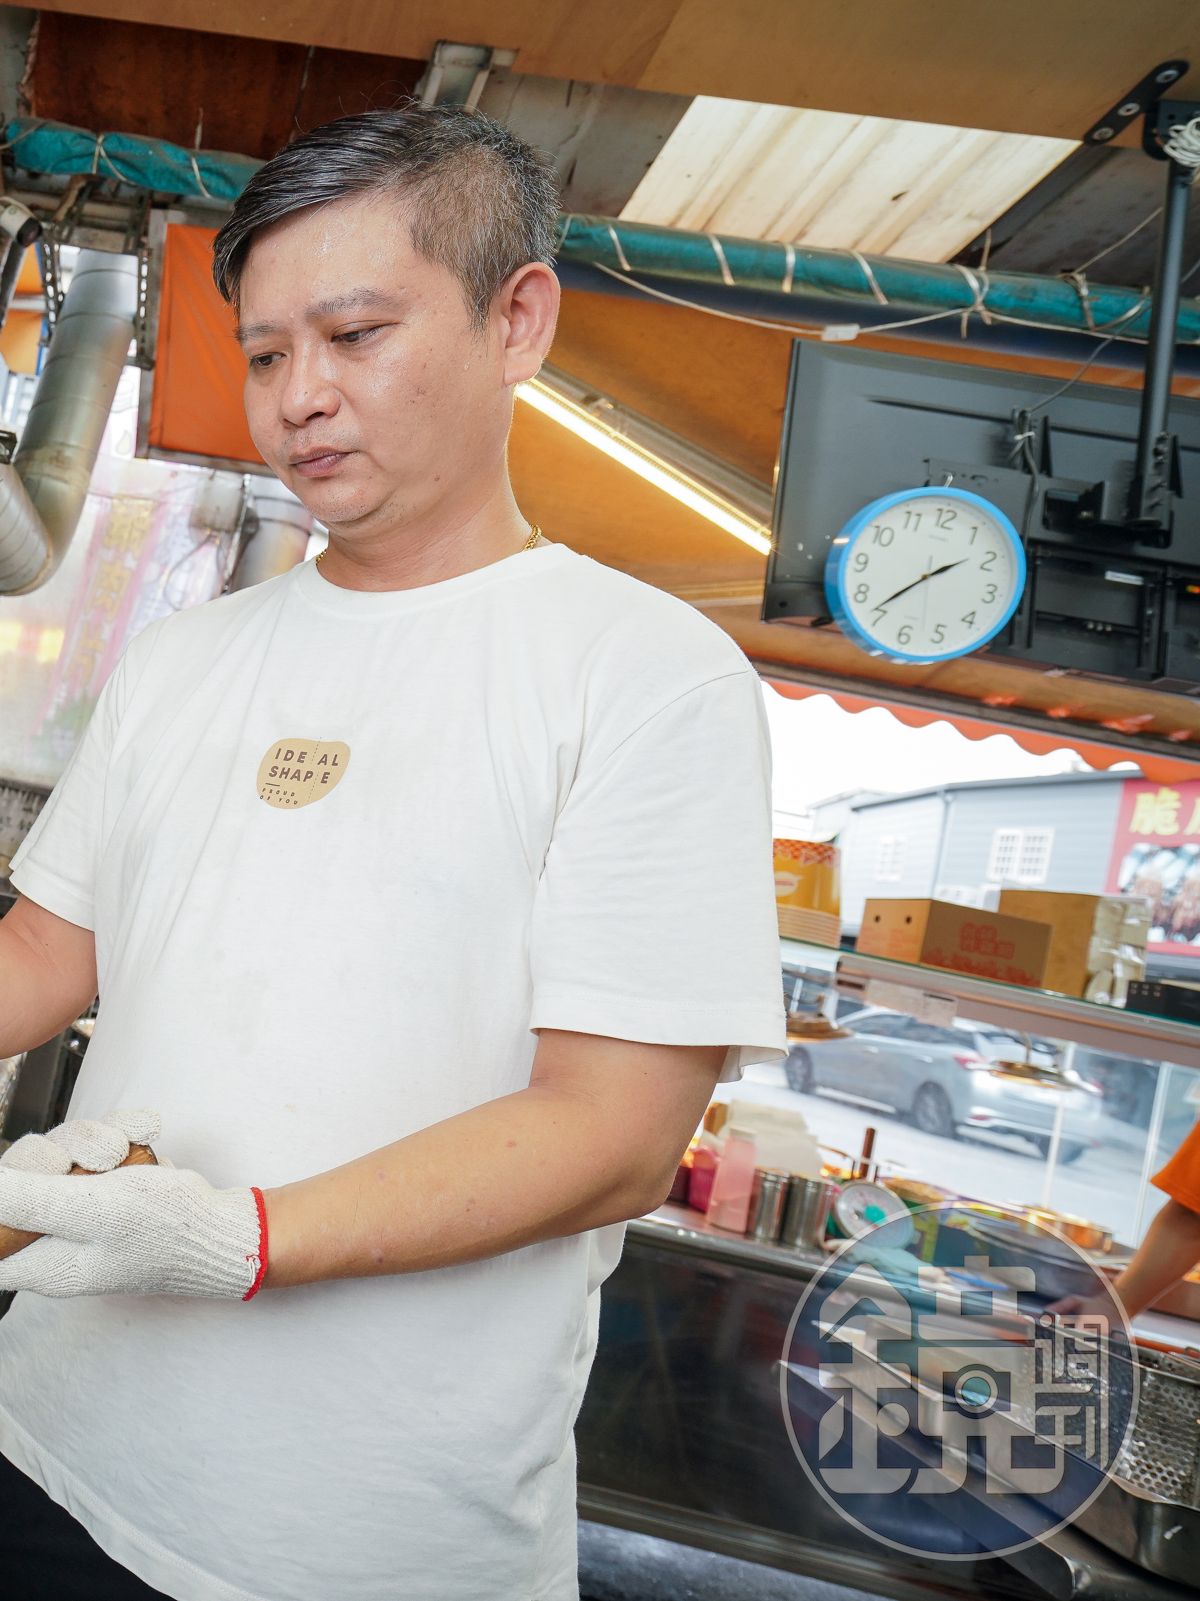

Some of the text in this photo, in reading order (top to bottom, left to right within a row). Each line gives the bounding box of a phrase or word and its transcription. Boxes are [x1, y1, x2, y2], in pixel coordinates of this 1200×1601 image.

[903, 511, 922, 532] 11
[936, 508, 958, 530] 12
[871, 525, 895, 548] 10
[968, 527, 978, 545] 1
[853, 552, 870, 573] 9
[979, 551, 998, 572] 2
[853, 583, 870, 604] 8
[981, 583, 998, 604] 3
[870, 607, 888, 628] 7
[960, 611, 977, 630] 4
[896, 624, 914, 645] 6
[930, 623, 948, 645] 5
